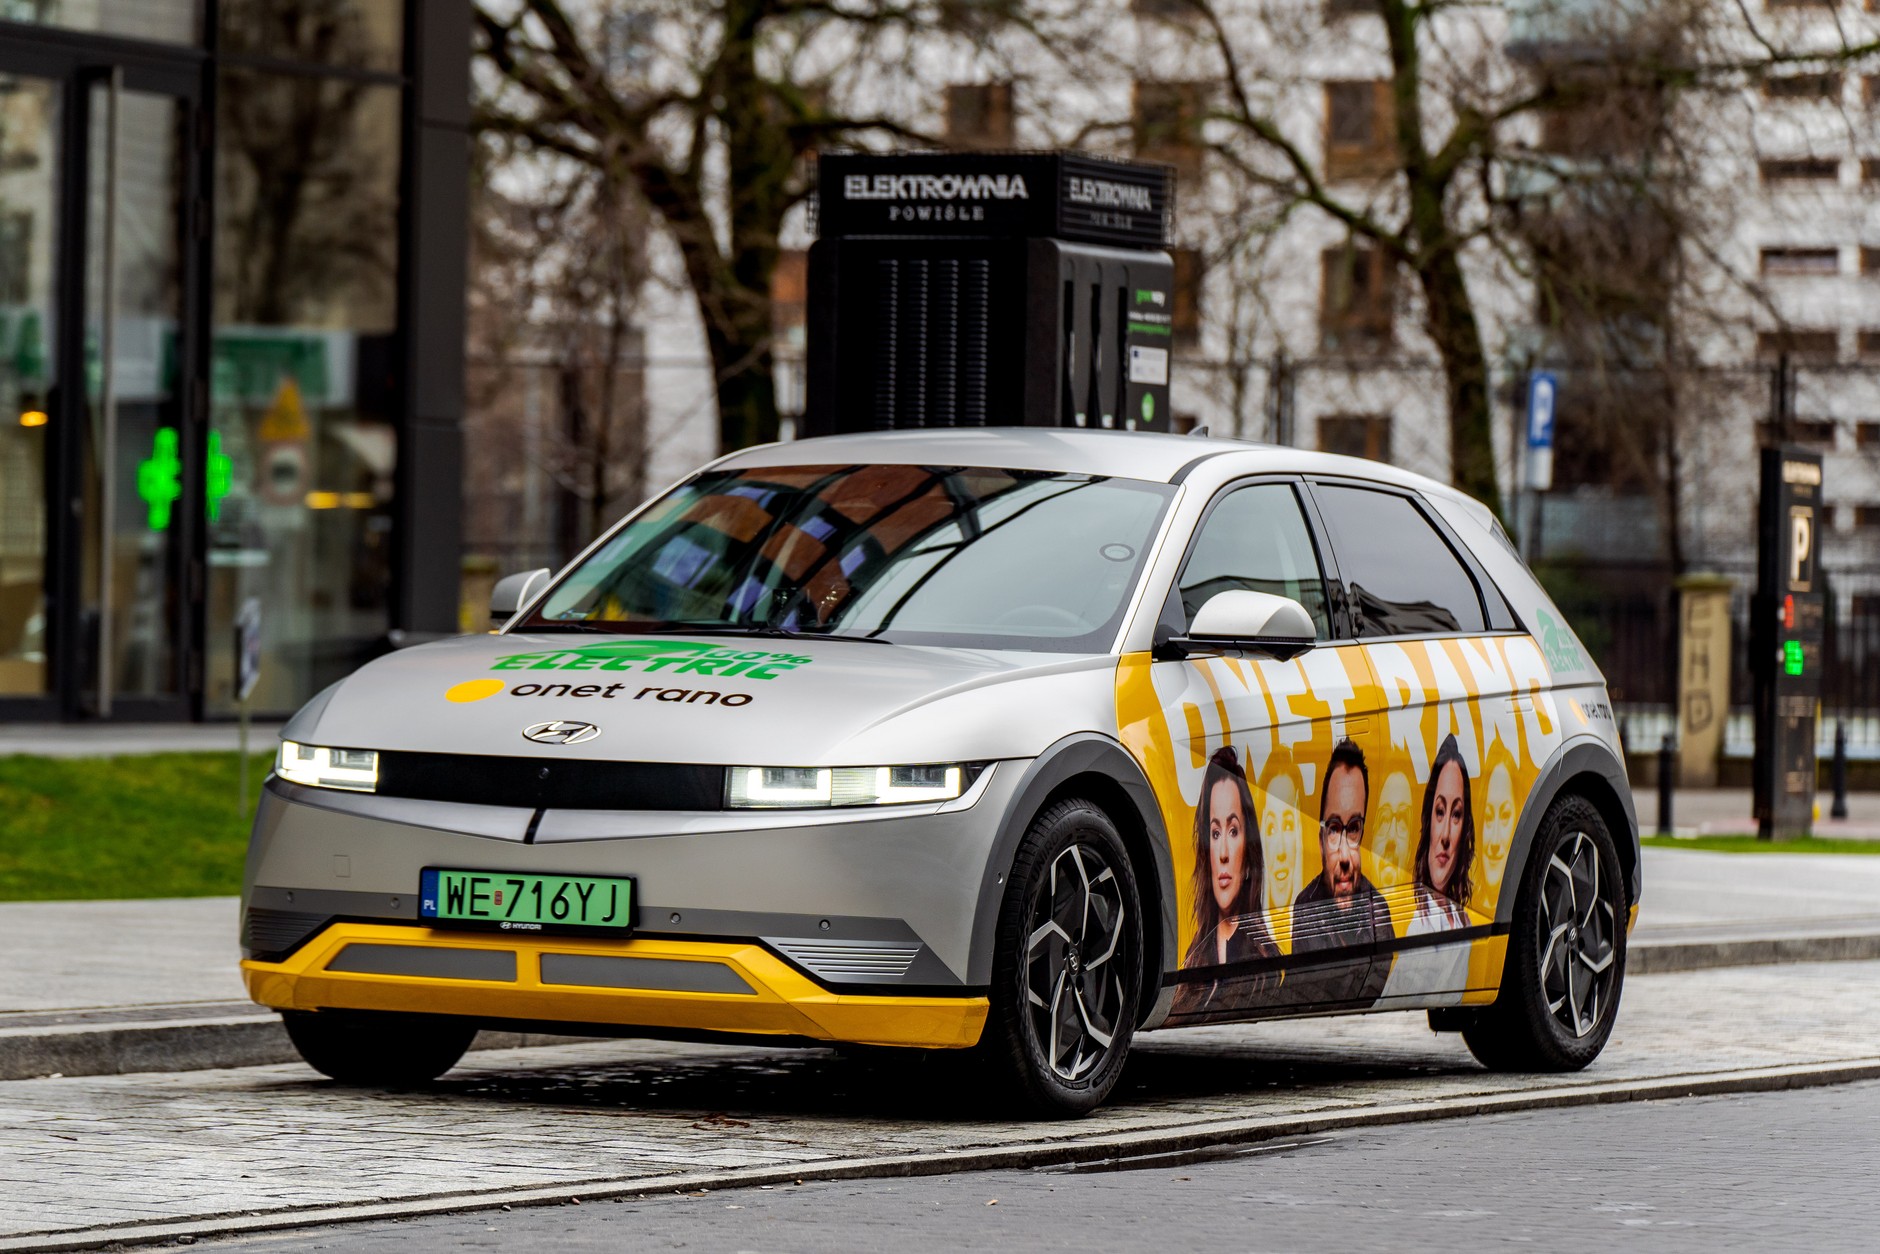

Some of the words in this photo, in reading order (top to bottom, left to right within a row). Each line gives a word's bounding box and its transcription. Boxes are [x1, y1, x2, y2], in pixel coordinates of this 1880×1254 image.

[844, 174, 1029, 200] ELEKTROWNIA
[888, 203, 984, 221] POWIŚLE
[1790, 515, 1810, 581] P
[489, 652, 799, 680] ELECTRIC
[510, 683, 625, 699] onet
[633, 686, 753, 708] rano
[1366, 637, 1562, 785] RANO
[424, 900, 436, 910] PL
[447, 876, 491, 916] WE
[505, 879, 617, 923] 716YJ
